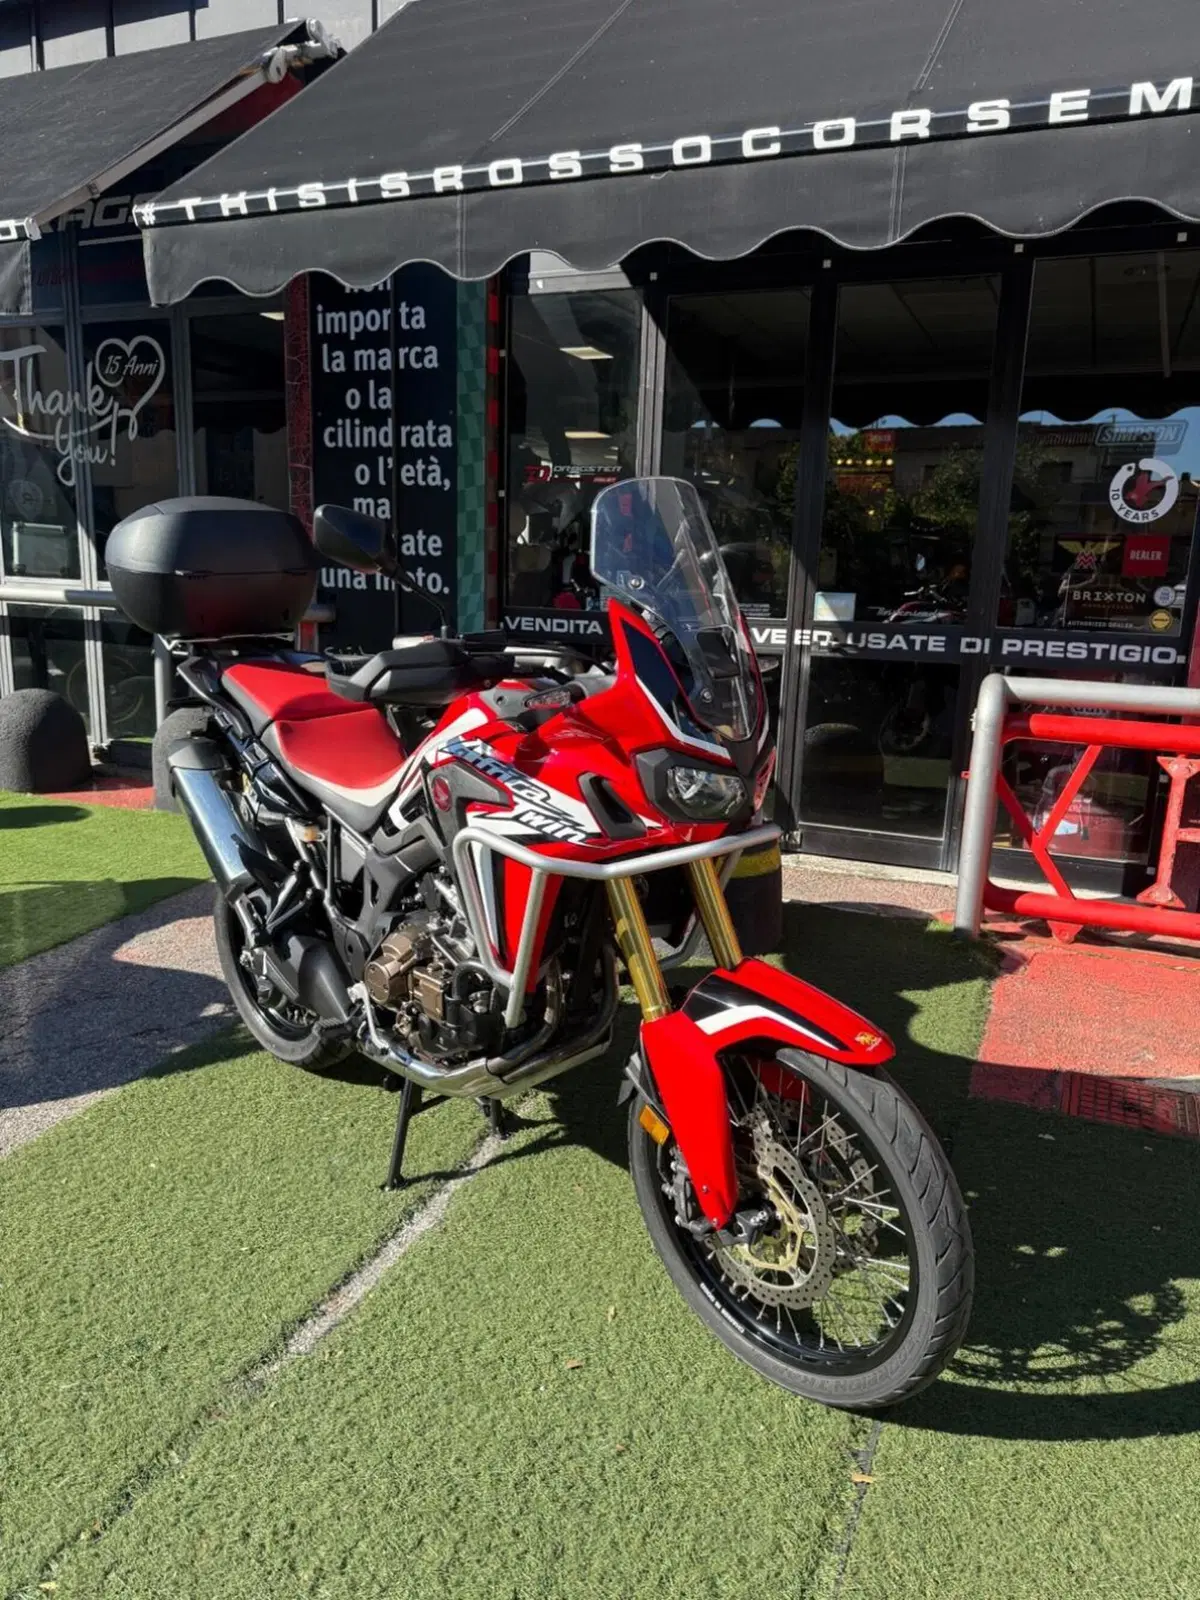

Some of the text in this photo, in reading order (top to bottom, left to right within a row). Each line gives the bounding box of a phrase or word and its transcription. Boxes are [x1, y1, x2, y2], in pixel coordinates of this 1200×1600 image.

[105, 355, 159, 376] 15 Anni
[322, 343, 438, 372] la marca
[0, 344, 113, 430] Thank
[345, 380, 392, 410] o la
[323, 418, 452, 448] cilindrata
[1101, 425, 1181, 441] SIMPSON
[355, 464, 370, 485] o
[353, 497, 391, 520] ma
[1111, 488, 1160, 521] 10 YEARS
[1129, 550, 1162, 560] DEALER
[321, 567, 367, 590] una
[1072, 590, 1147, 604] BRIXTON
[504, 615, 604, 636] VENDITA
[847, 632, 946, 652] USATE
[960, 637, 990, 655] DI
